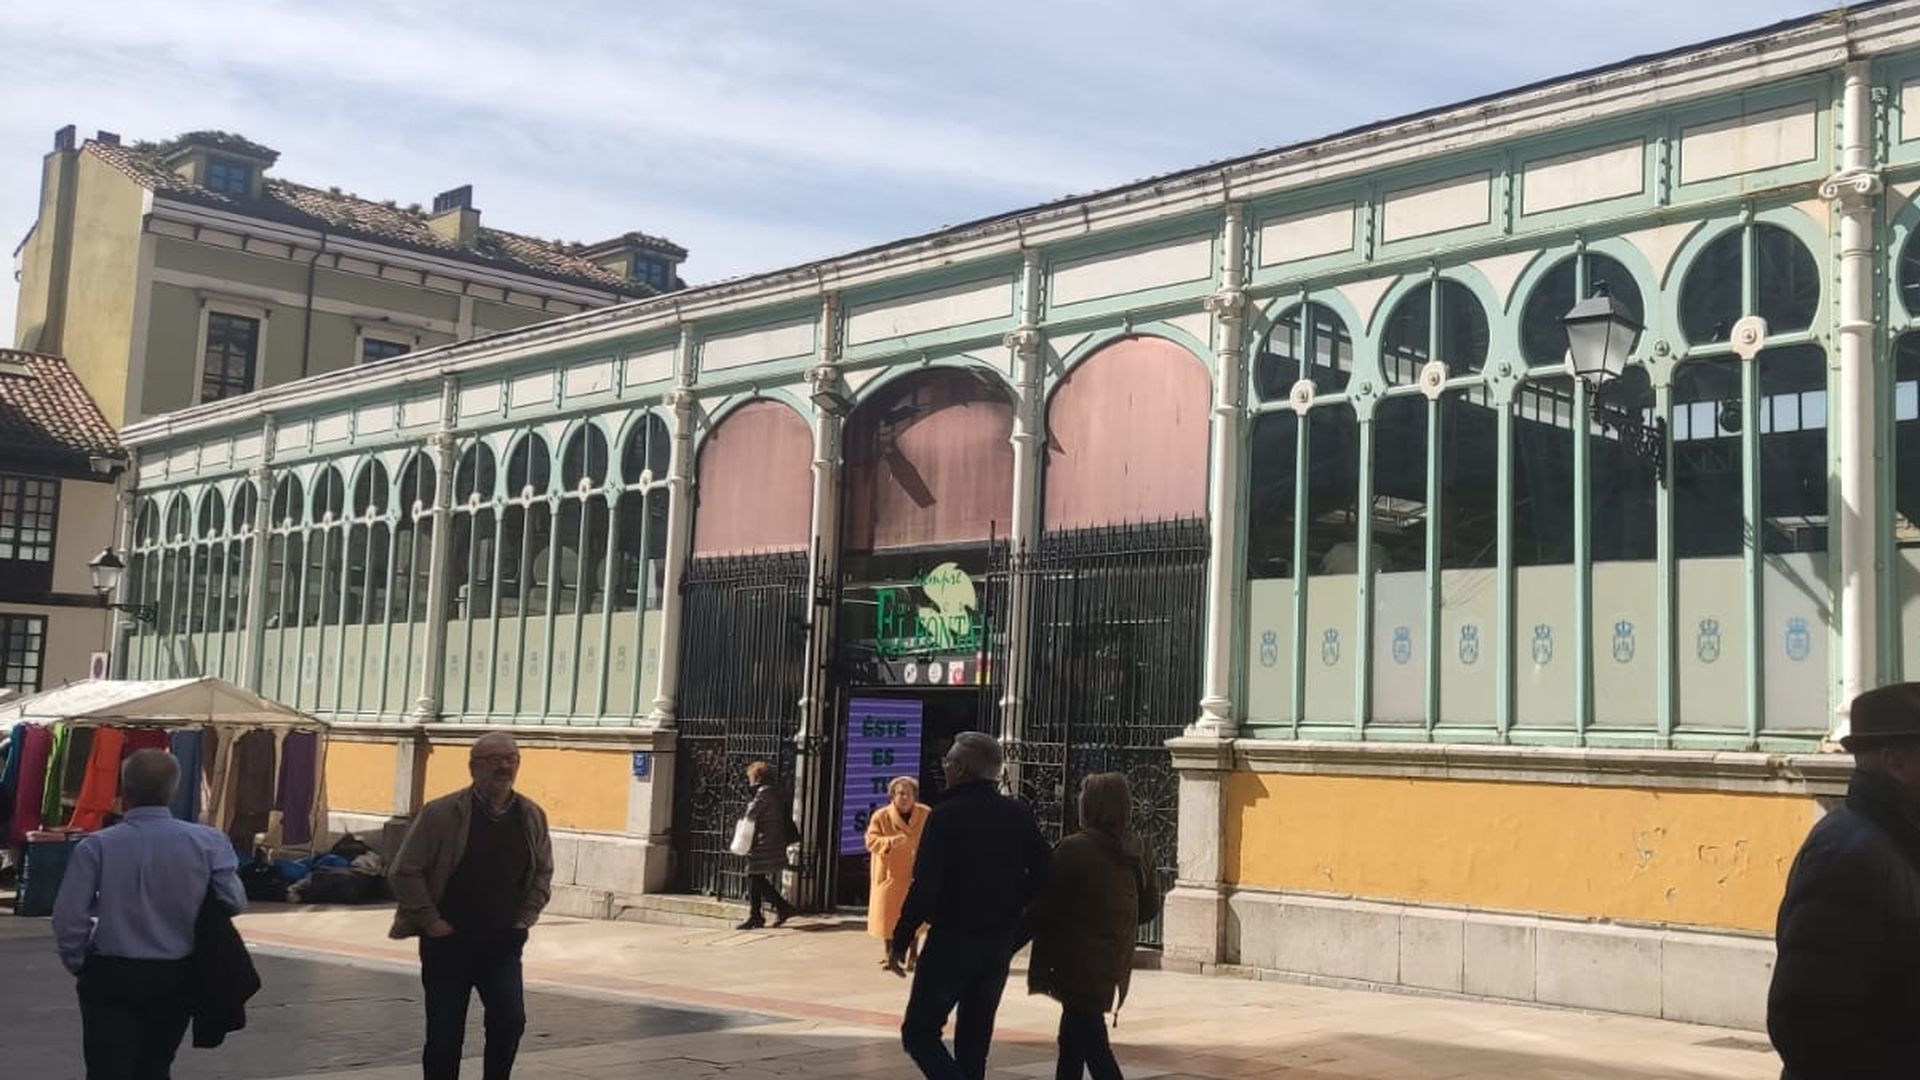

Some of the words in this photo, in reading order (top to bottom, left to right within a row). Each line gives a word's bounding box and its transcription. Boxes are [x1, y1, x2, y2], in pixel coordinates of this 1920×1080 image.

[914, 611, 990, 652] FONT
[863, 715, 907, 737] ÉSTE
[871, 747, 895, 766] ES
